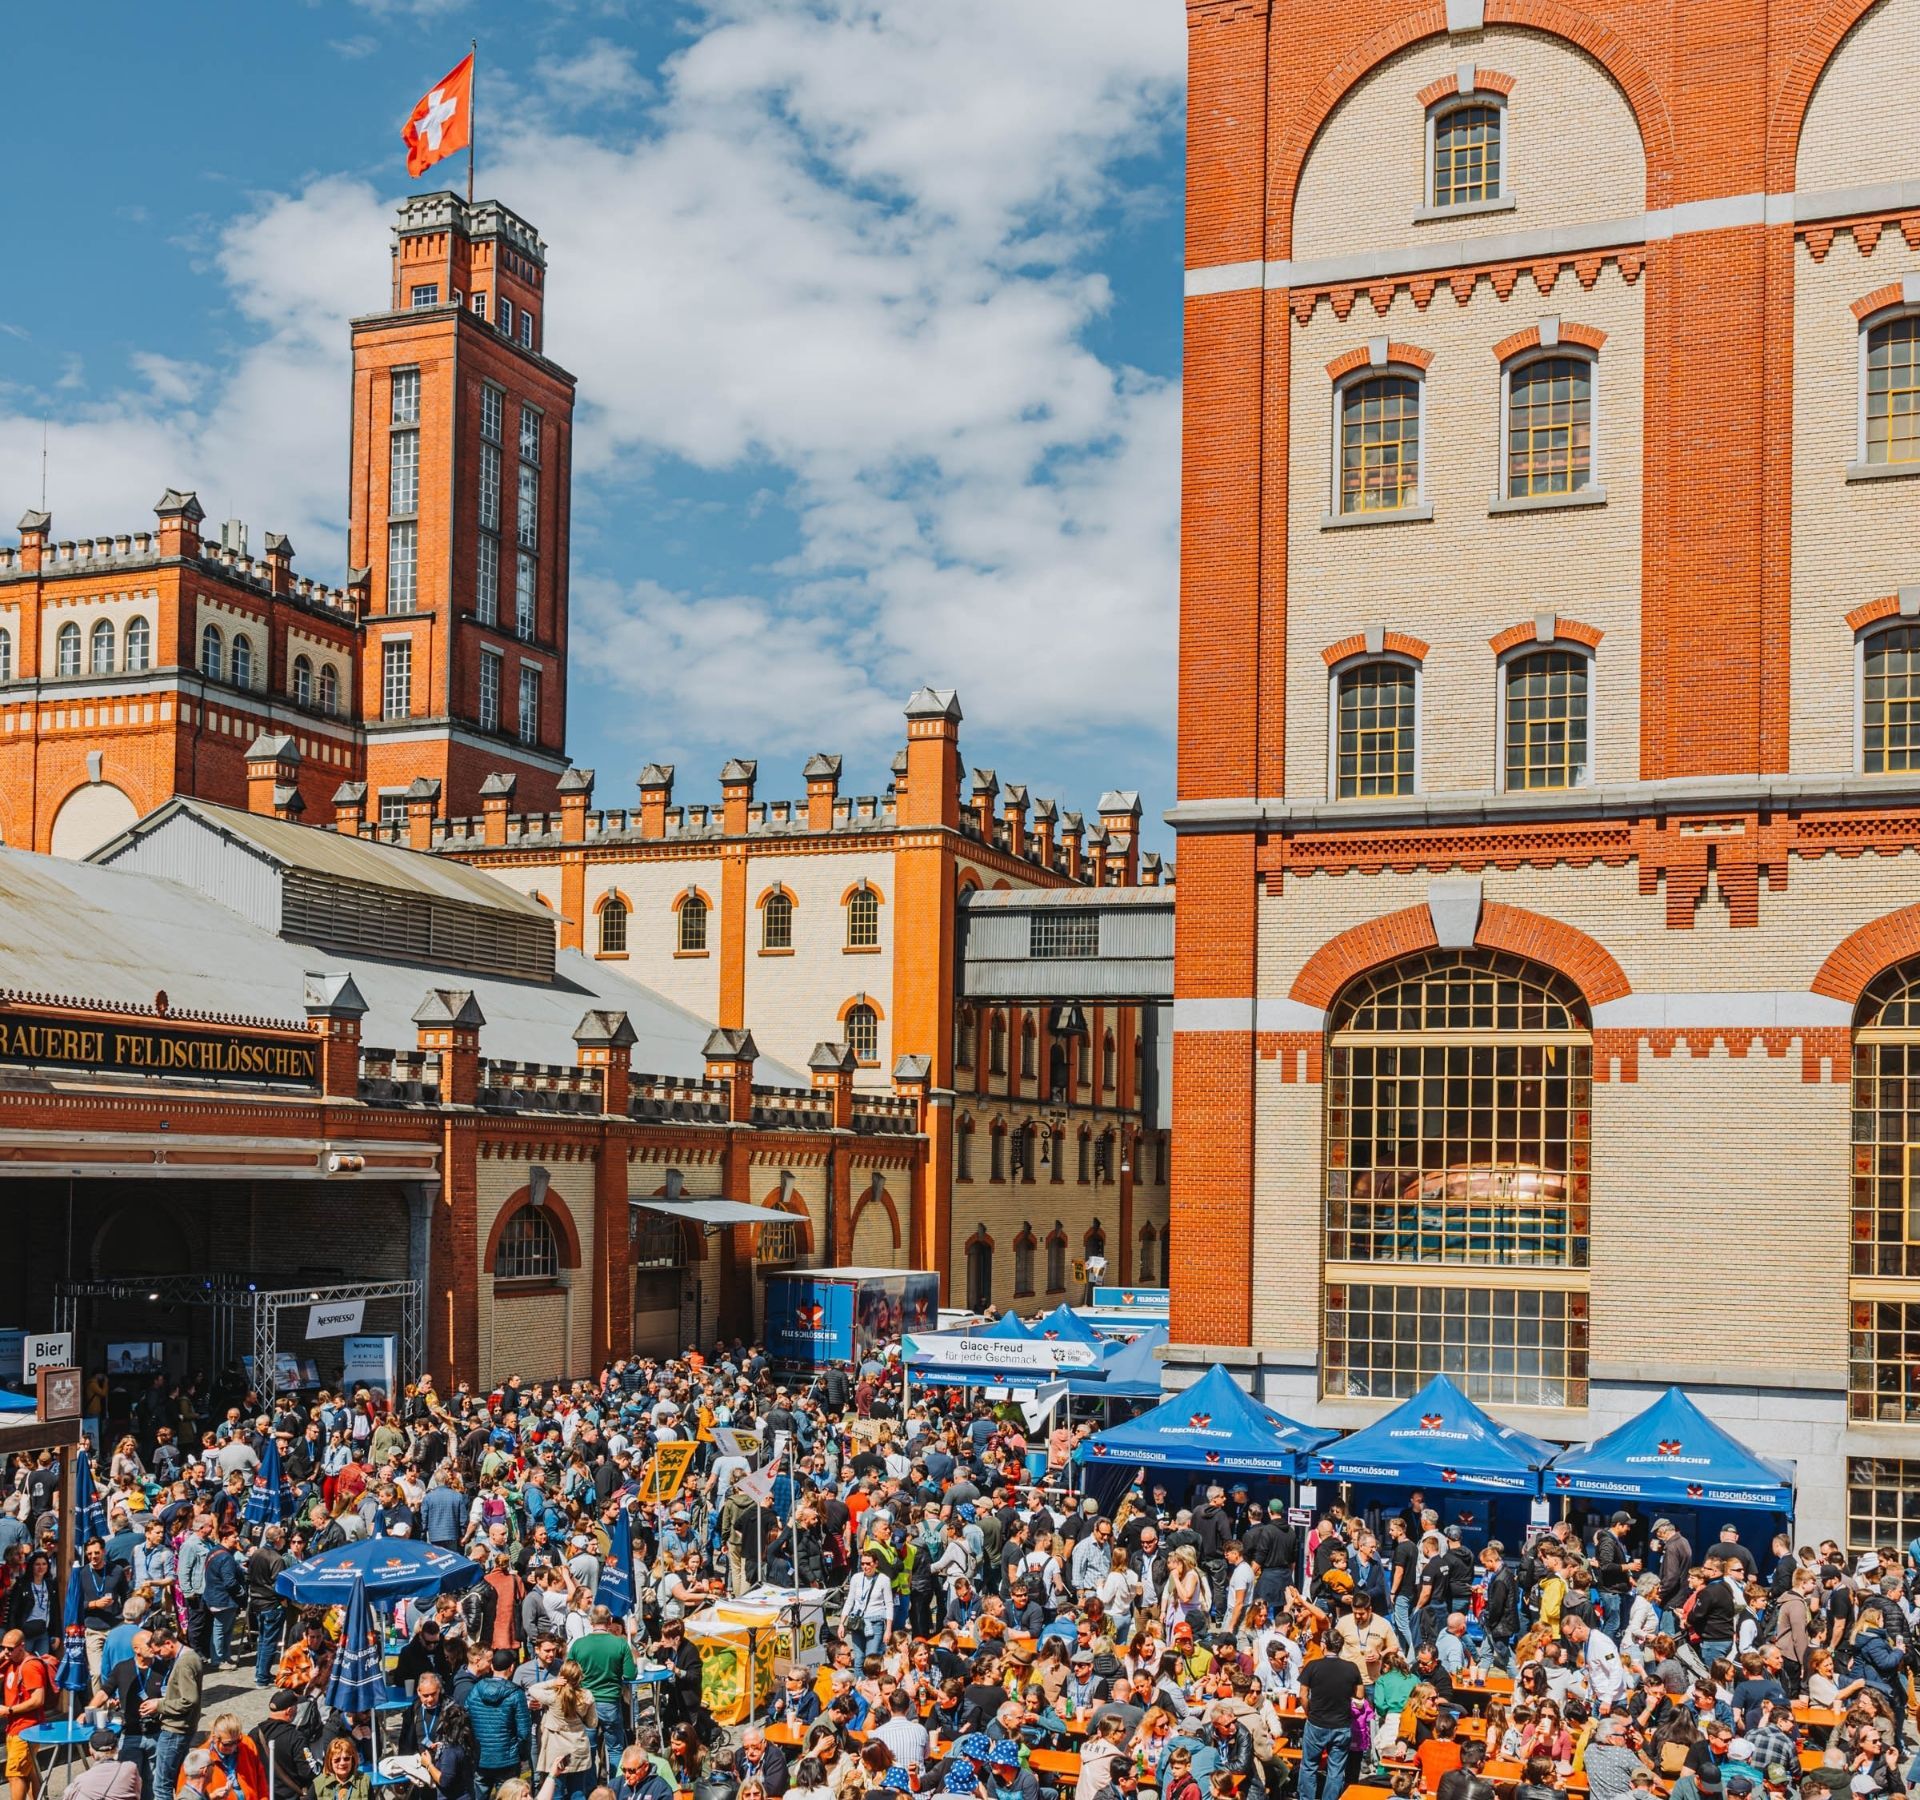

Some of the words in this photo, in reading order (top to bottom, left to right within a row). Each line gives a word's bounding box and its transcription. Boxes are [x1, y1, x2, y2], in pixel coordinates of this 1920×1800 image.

[115, 1034, 315, 1077] FELDSCHLÖSSCHEN
[318, 1314, 354, 1326] NESPRESSO
[36, 1342, 63, 1357] Bier
[960, 1341, 1023, 1353] Glace-Freud
[945, 1351, 958, 1361] für
[961, 1353, 983, 1363] jede
[985, 1353, 1038, 1365] Gschmack
[1159, 1427, 1233, 1438] FELDSCHLÖSSCHEN
[1390, 1430, 1469, 1440] FELDSCHLÖSSCHEN
[1110, 1449, 1167, 1461] FELDSCHLÖSSCHEN
[1626, 1455, 1711, 1465] FELDSCHLÖSSCHEN
[1223, 1457, 1282, 1468] FELDSCHLÖSSCHEN
[1338, 1465, 1399, 1477] FELDSCHLÖSSCHEN
[1575, 1480, 1641, 1493] FELDSCHLÖSSCHEN
[1708, 1490, 1776, 1503] FELDSCHLÖSSCHEN
